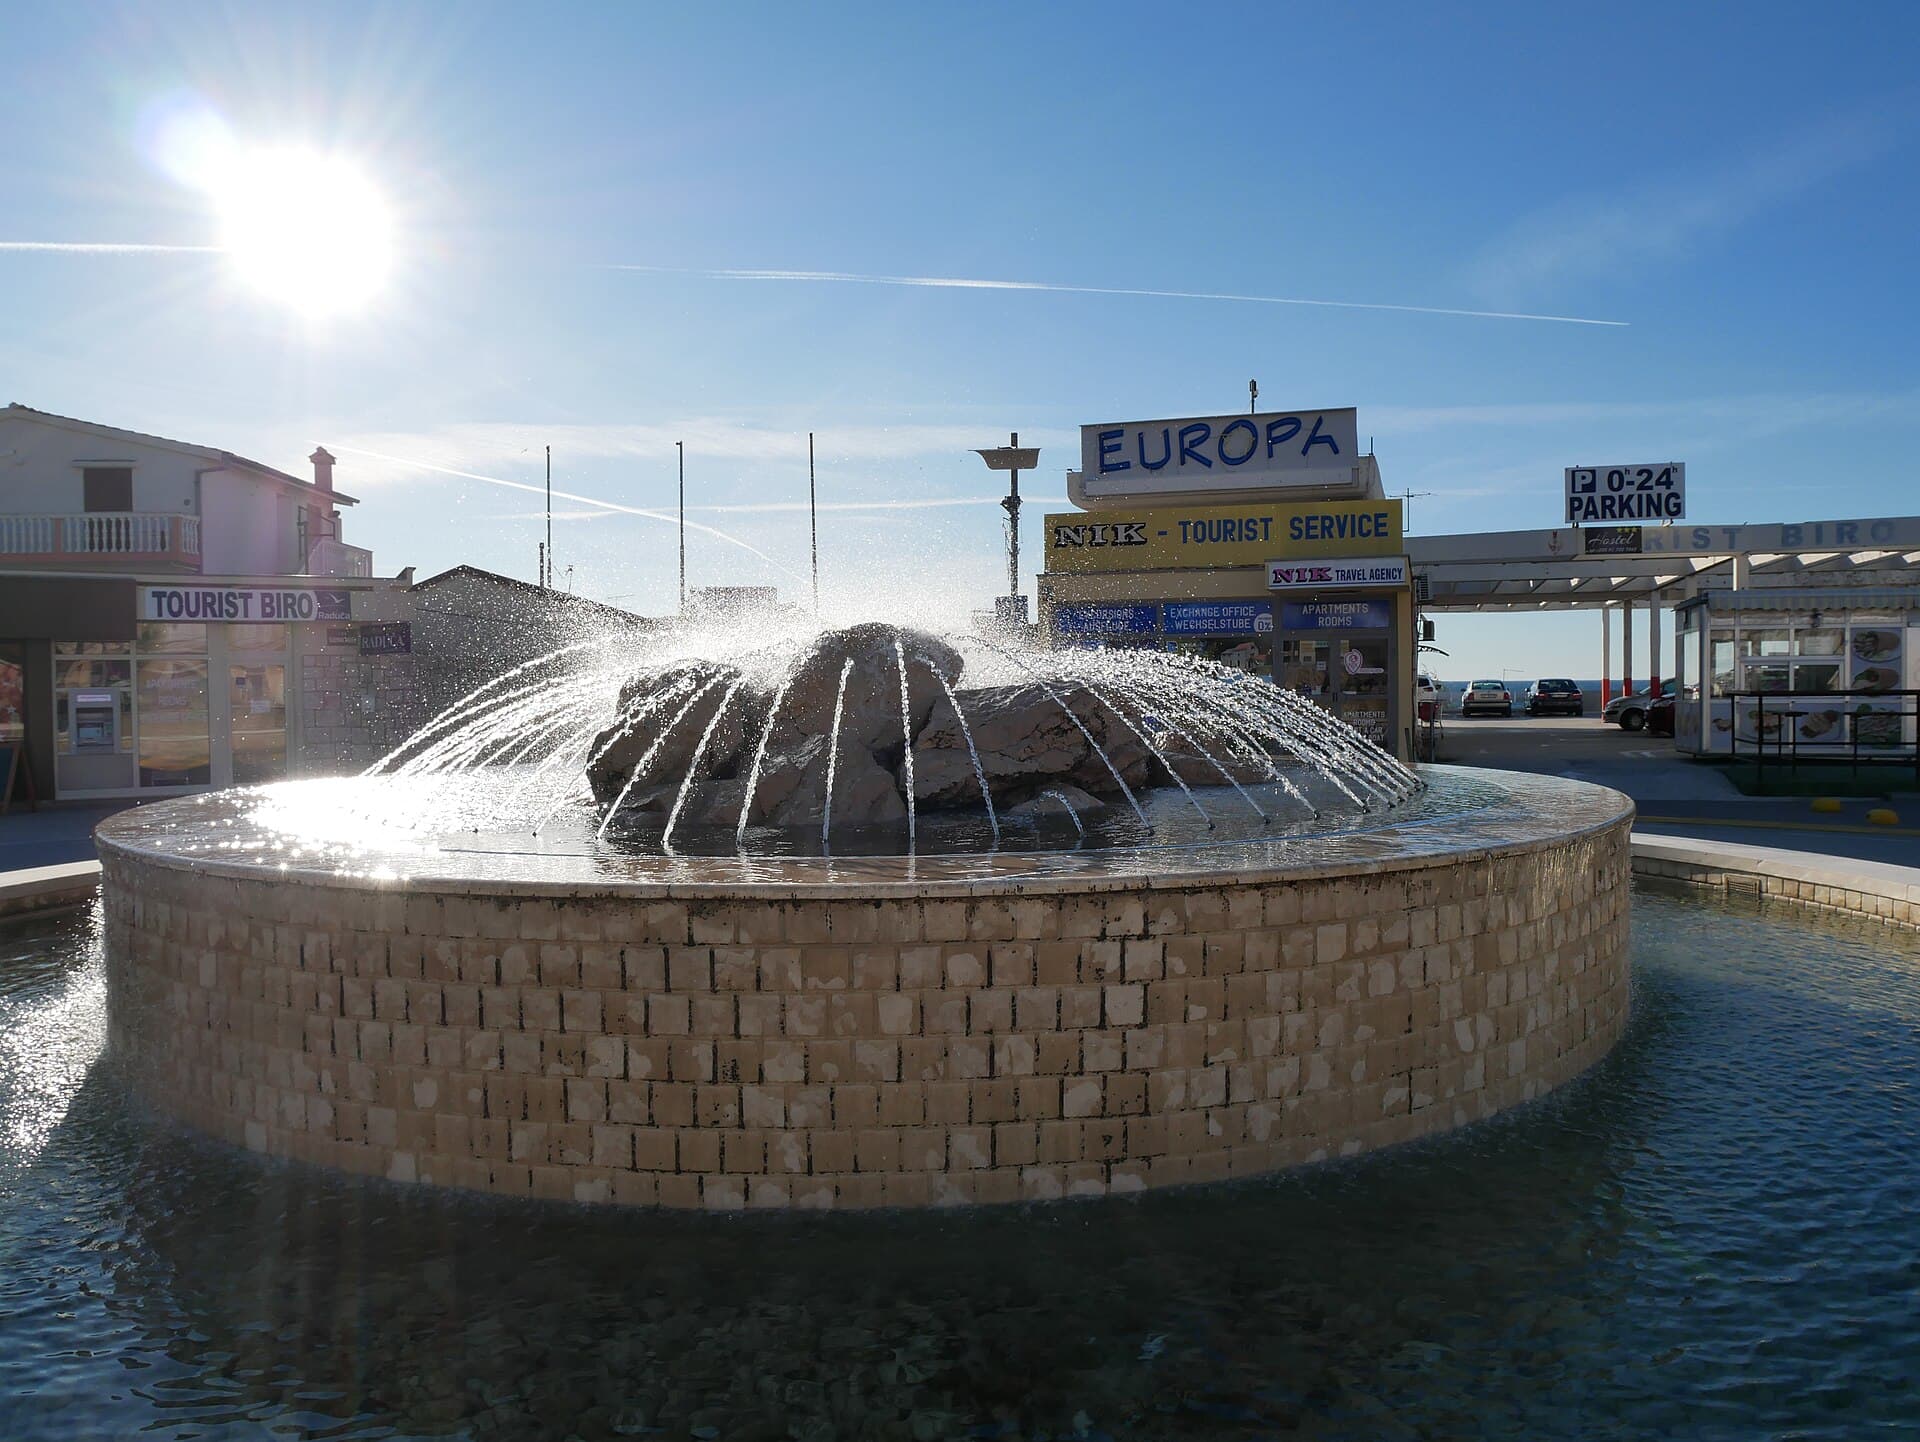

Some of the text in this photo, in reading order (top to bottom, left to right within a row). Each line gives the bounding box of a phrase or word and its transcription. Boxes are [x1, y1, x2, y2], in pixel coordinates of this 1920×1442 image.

[1099, 416, 1340, 474] EUROPA
[1573, 470, 1593, 492] P
[1569, 492, 1682, 520] PARKING
[1053, 522, 1148, 548] NIK
[1178, 516, 1273, 544] TOURIST
[1289, 512, 1389, 541] SERVICE
[1782, 519, 1897, 547] BIRO
[1272, 567, 1404, 583] NIK TRAVEL AGENCY
[151, 590, 314, 619] TOURIST BIRO
[1170, 606, 1257, 618] EXCHANGE OFFICE
[1302, 602, 1369, 614] APARTMENTS
[1174, 618, 1251, 630] WECHSELSTUBE
[1318, 616, 1353, 627] ROOMS
